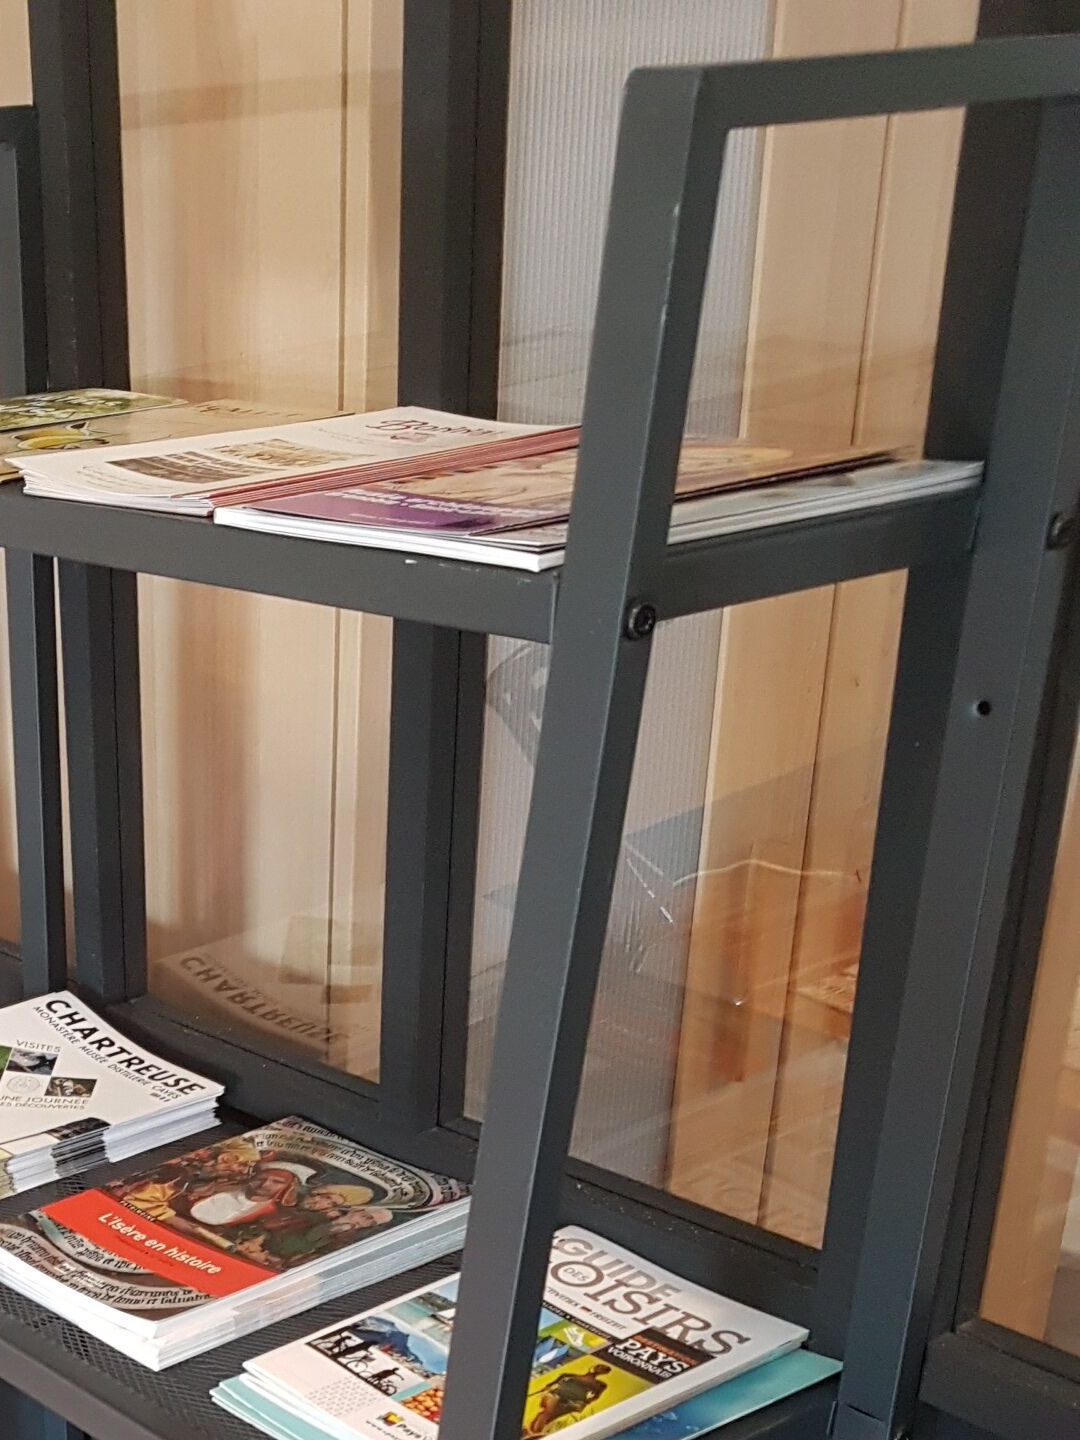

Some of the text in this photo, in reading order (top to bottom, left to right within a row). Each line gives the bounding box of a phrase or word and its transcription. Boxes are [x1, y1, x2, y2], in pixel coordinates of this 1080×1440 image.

[16, 1040, 61, 1053] VISITES
[45, 999, 207, 1096] CHARTREUSE
[80, 1045, 109, 1065] MUSÉE
[26, 1094, 89, 1105] JOURNÉE
[98, 1212, 222, 1276] L'Isère en histoire
[555, 1238, 683, 1298] GUIDE
[563, 1267, 592, 1283] DES
[550, 1260, 752, 1358] OISIRS
[607, 1346, 674, 1380] VOIRONNAIS
[617, 1337, 691, 1374] PAYS
[395, 1422, 422, 1440] Pays
